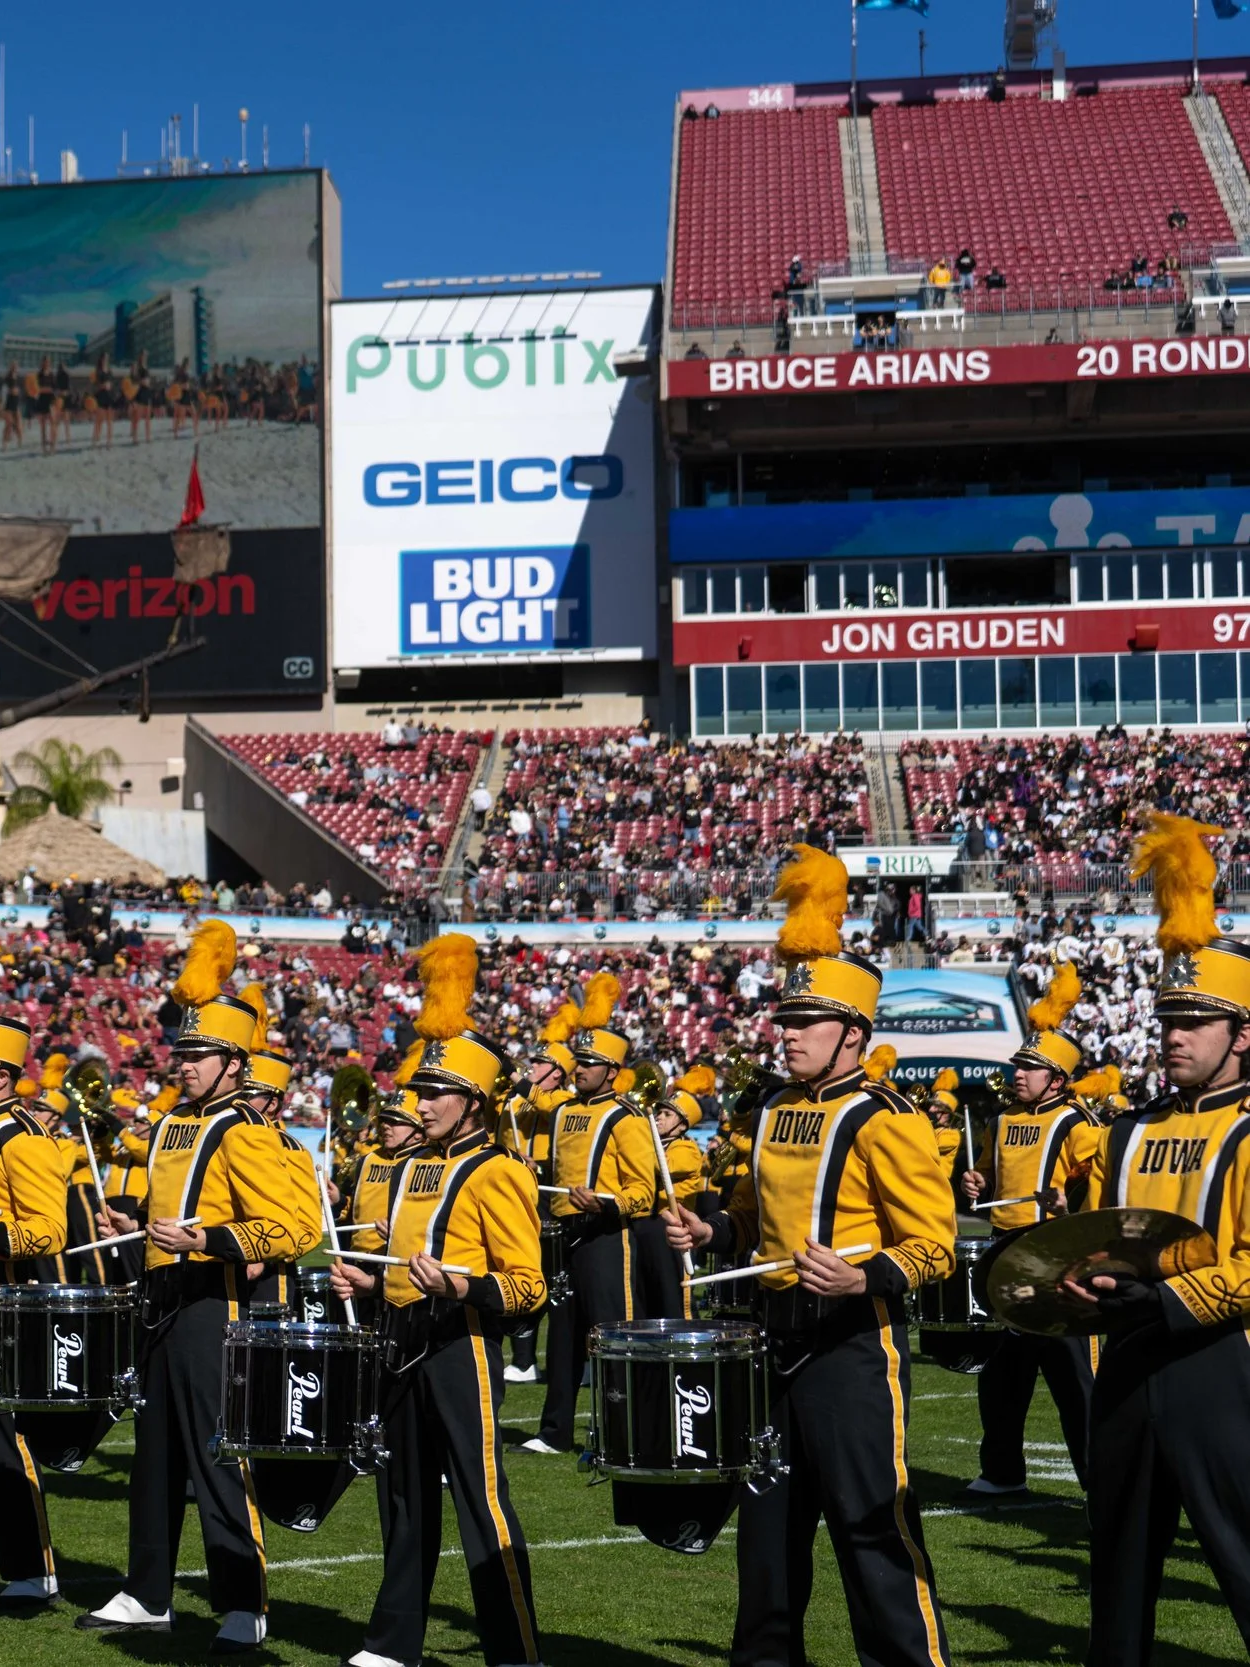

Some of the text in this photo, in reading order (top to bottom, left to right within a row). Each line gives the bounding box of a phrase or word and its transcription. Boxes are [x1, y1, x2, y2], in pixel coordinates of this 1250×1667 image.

[748, 89, 784, 107] 344
[708, 350, 991, 392] BRUCE ARIANS
[1075, 337, 1250, 376] 20 ROND
[363, 454, 624, 507] GEICO
[30, 565, 255, 622] verizon
[433, 556, 556, 601] BUD
[409, 598, 579, 645] LIGHT
[821, 617, 1066, 654] JON GRUDEN
[1212, 612, 1250, 642] 97
[284, 660, 312, 675] CC
[884, 855, 934, 873] RIPA
[161, 1123, 201, 1151] IOWA
[563, 1115, 592, 1132] IOWA
[769, 1109, 826, 1145] IOWA
[1004, 1124, 1041, 1147] IOWA
[1138, 1137, 1209, 1176] IOWA
[408, 1163, 446, 1194] IOWA
[231, 1223, 254, 1259] HAWKEYES
[53, 1323, 83, 1393] Pearl
[287, 1361, 321, 1439] Pearl
[674, 1374, 712, 1459] Pearl
